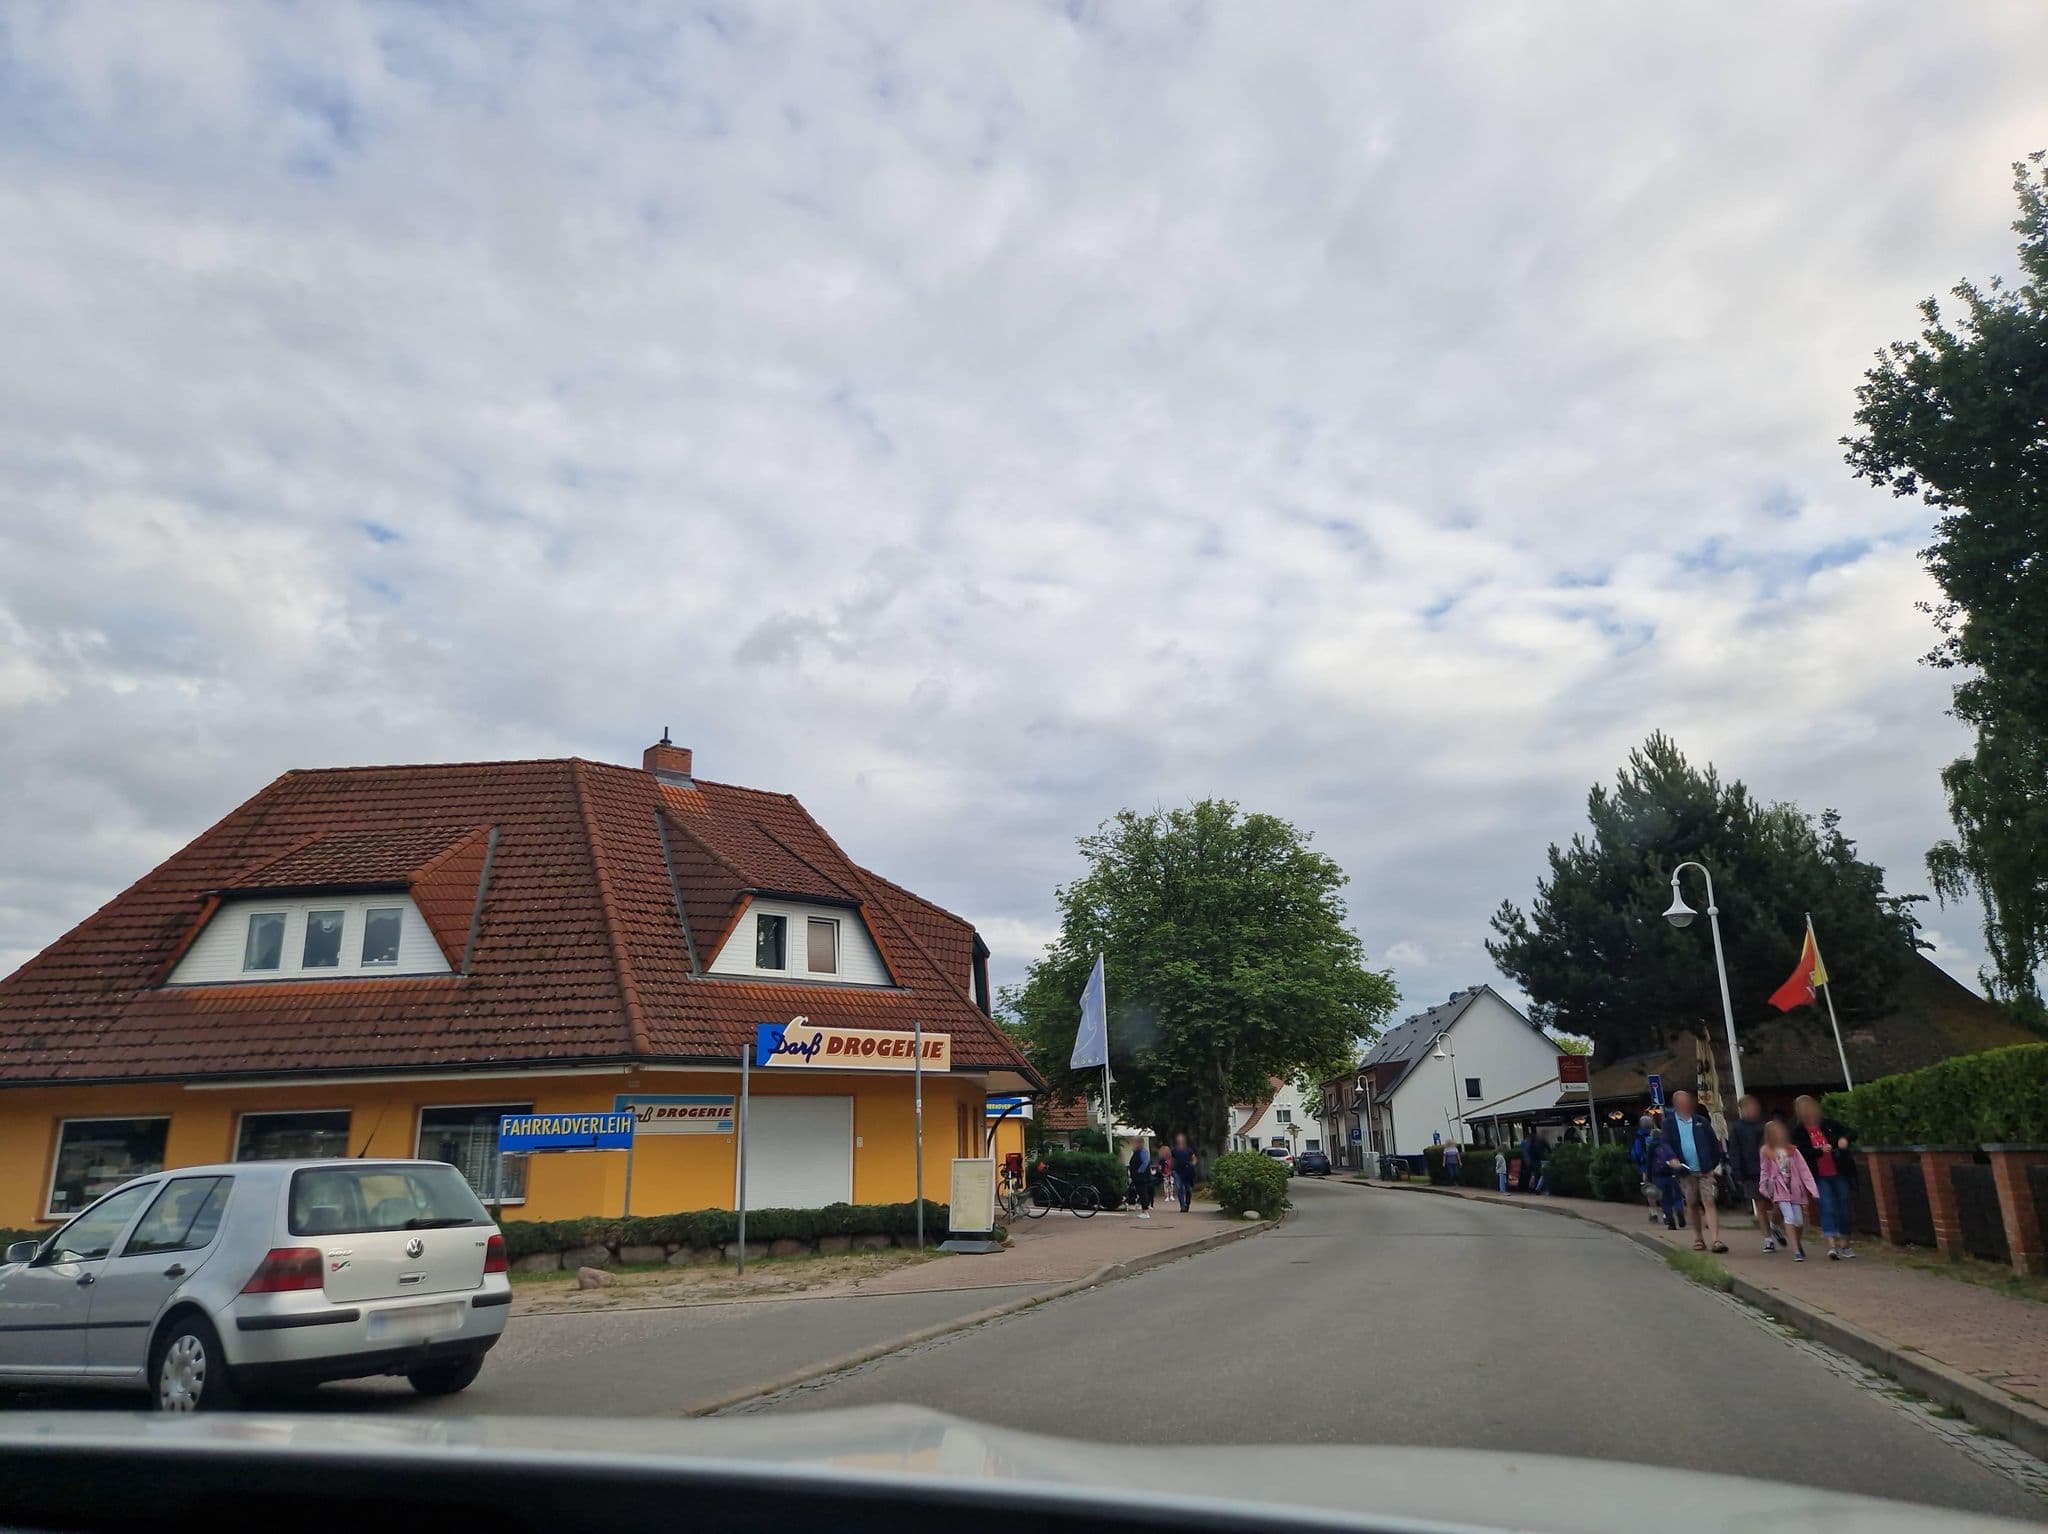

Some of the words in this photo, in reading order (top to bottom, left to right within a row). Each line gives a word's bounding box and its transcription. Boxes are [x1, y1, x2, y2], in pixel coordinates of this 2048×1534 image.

[768, 1031, 823, 1063] Darß
[826, 1036, 945, 1059] DROGERIE
[656, 1107, 732, 1118] DROGERIE
[502, 1116, 632, 1136] FAHRRADVERLEIH
